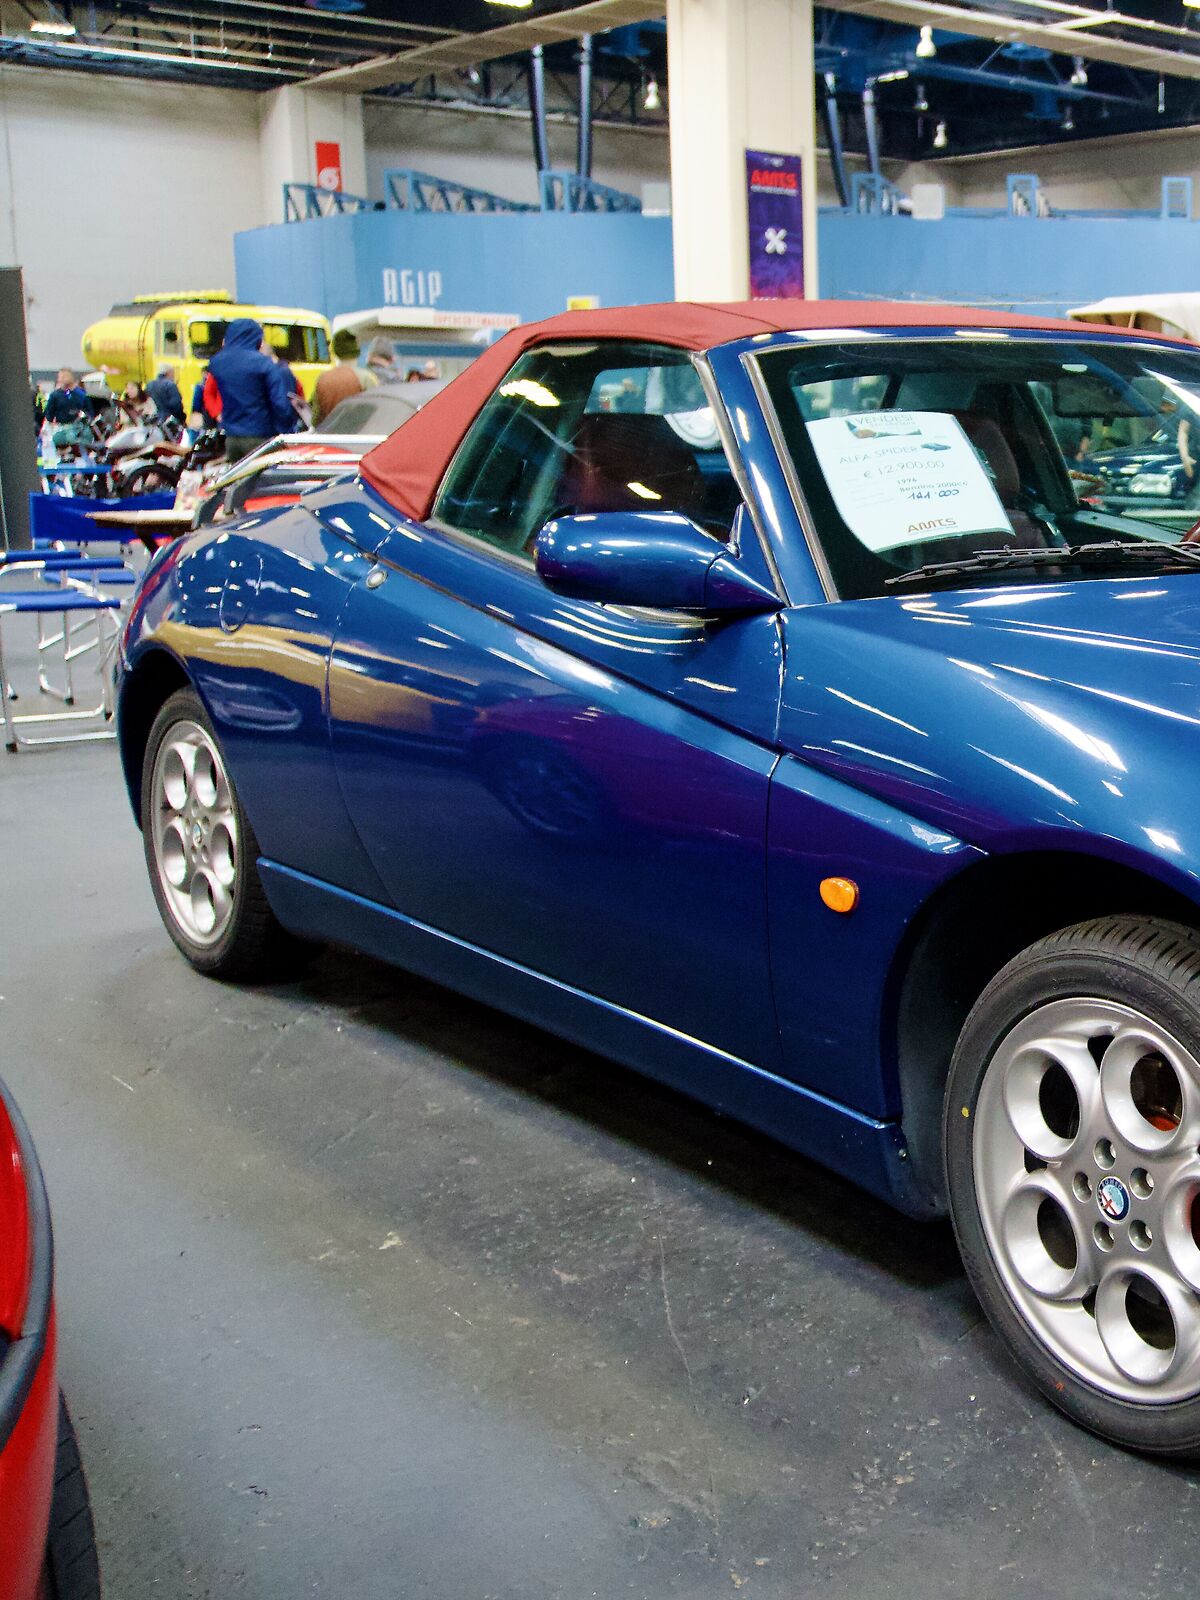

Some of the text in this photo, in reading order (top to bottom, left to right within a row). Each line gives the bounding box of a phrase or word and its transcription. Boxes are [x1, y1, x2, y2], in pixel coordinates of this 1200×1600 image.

[751, 169, 798, 189] AMTS
[383, 268, 441, 305] AGIP
[855, 413, 914, 425] VENDESI
[839, 446, 918, 464] ALFA SPIDER
[907, 517, 957, 533] AMTS
